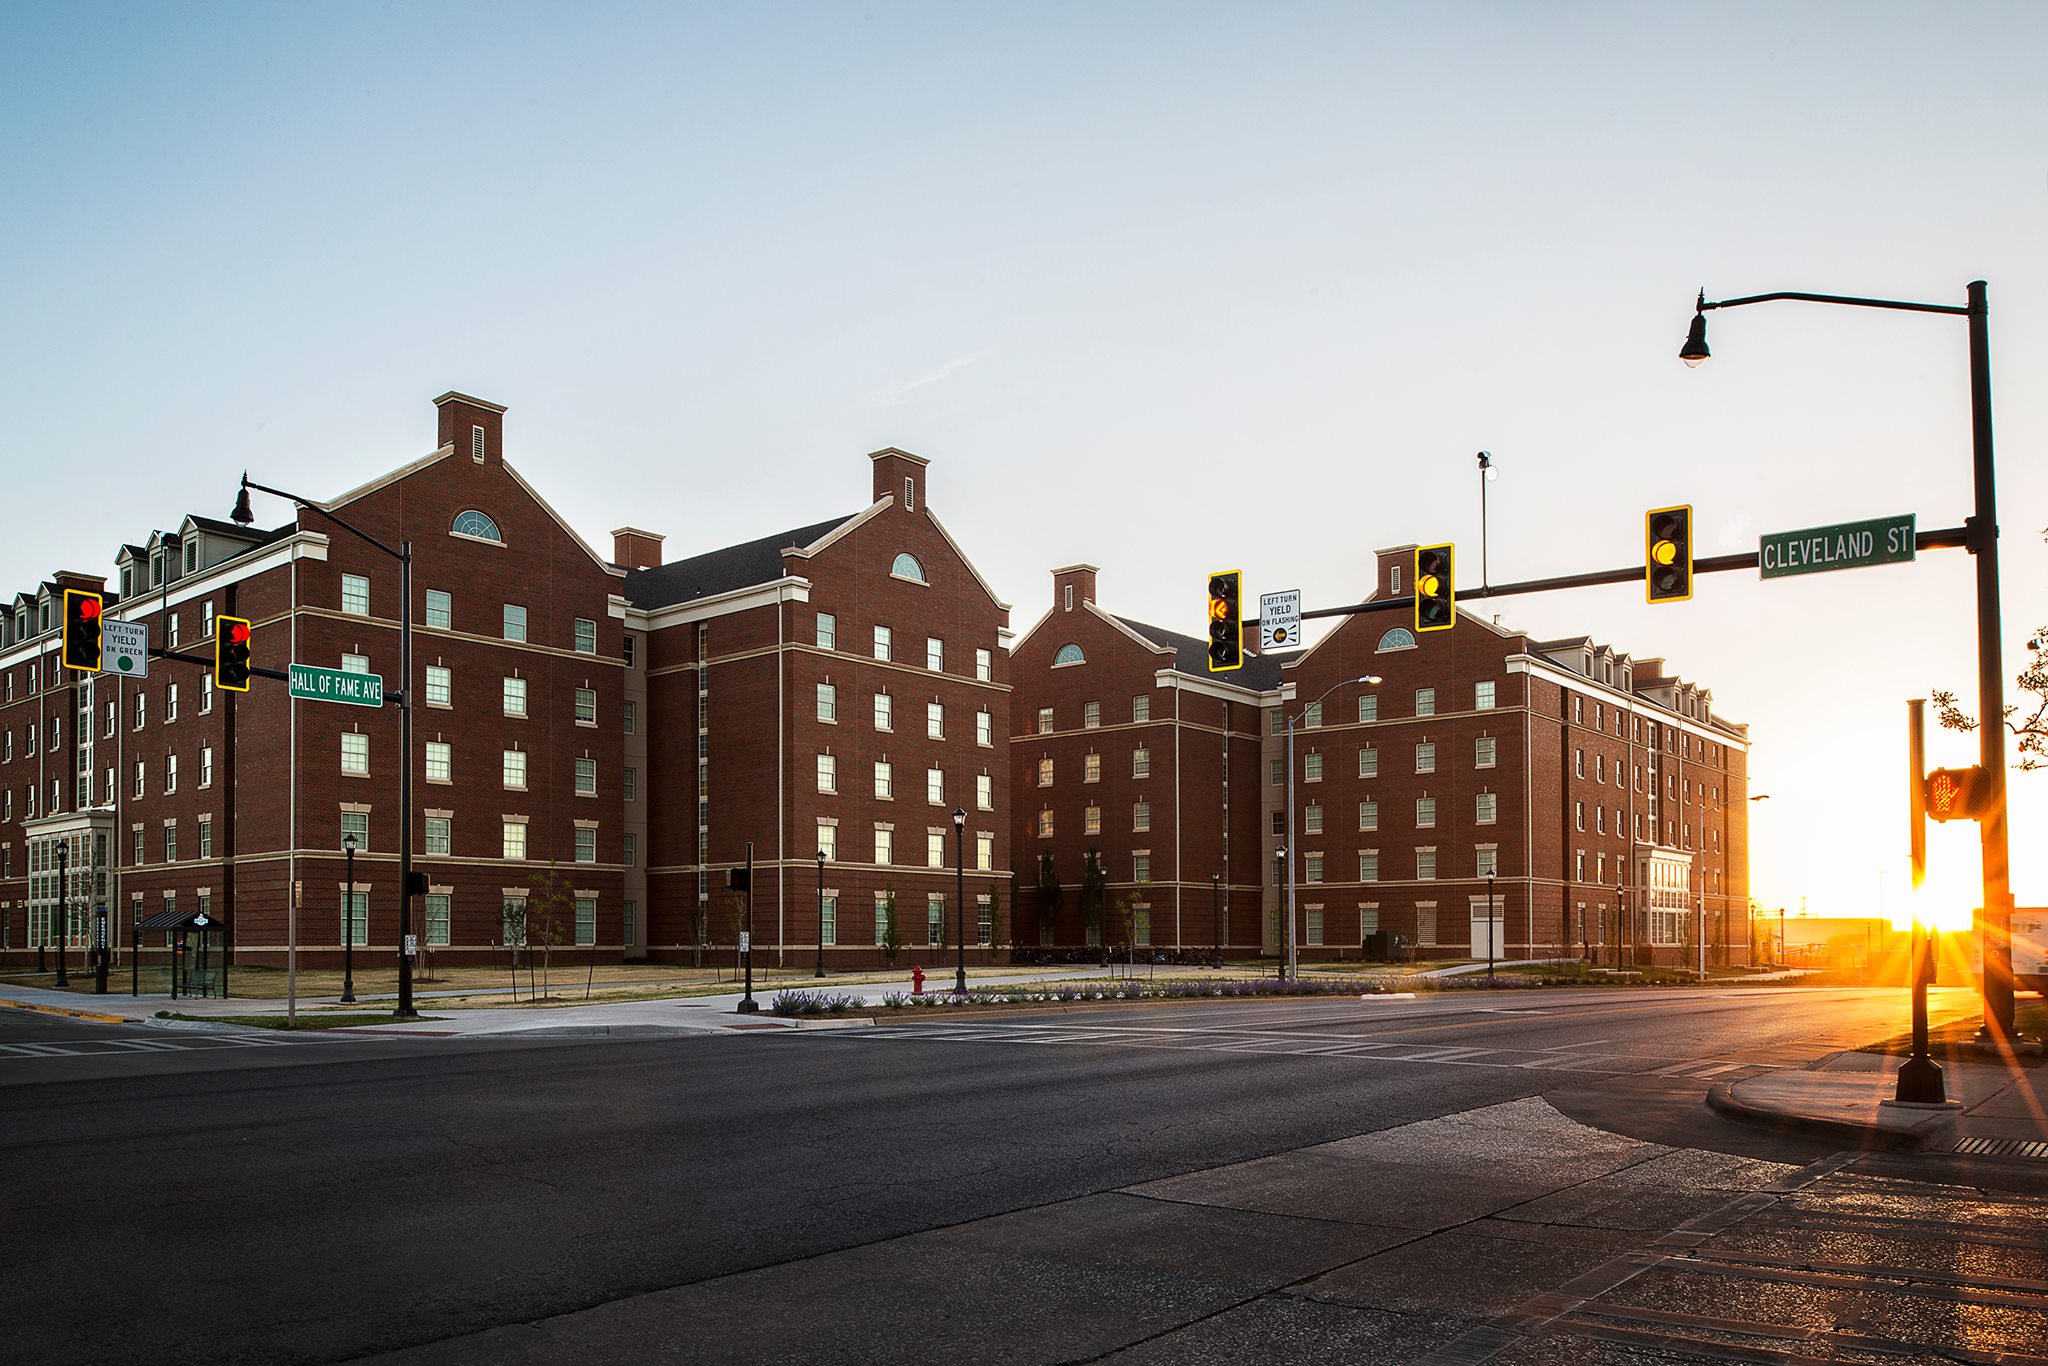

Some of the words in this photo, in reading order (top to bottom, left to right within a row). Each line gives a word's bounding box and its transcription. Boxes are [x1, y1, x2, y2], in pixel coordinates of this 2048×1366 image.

[1764, 531, 1873, 569] CLEVELAND
[1887, 525, 1910, 554] ST
[1263, 597, 1278, 605] LEFT
[1280, 594, 1297, 603] TURN
[1269, 604, 1291, 615] YIELD
[1271, 615, 1298, 625] FLASHING
[104, 624, 121, 632] LEFT
[125, 627, 144, 636] TURN
[112, 635, 137, 645] YIELD
[119, 647, 143, 656] GREEN
[291, 671, 316, 692] HALL
[319, 675, 331, 693] OF
[335, 677, 360, 697] FAME
[363, 681, 380, 700] AVE
